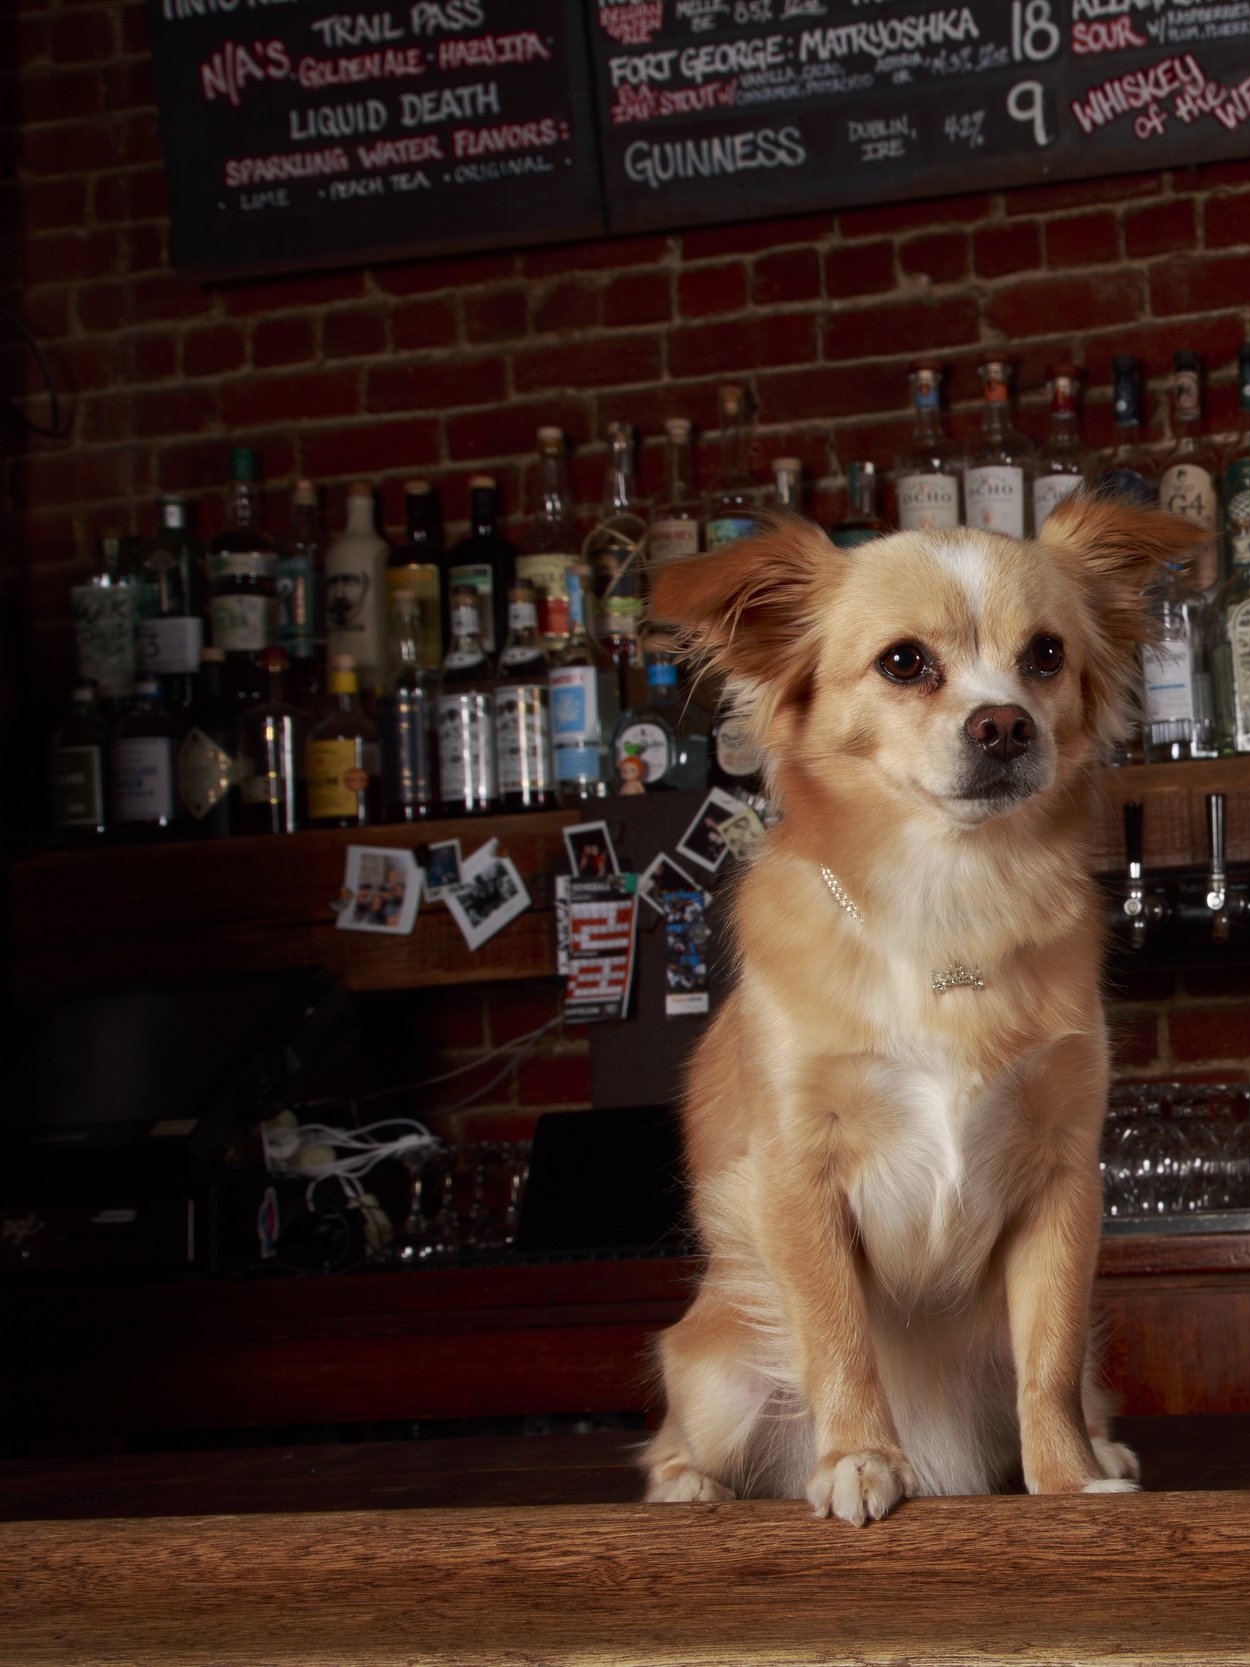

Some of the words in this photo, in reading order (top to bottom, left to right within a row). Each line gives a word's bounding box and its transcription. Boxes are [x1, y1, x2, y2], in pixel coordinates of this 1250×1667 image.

[311, 12, 406, 48] TRAIL
[410, 0, 486, 37] PASS
[800, 7, 980, 63] MATRYOSHKA
[1012, 0, 1060, 62] 18
[1072, 15, 1149, 55] SOUR
[299, 56, 383, 89] GOLDEN
[383, 48, 427, 79] ALE
[608, 50, 680, 88] FORT
[680, 34, 792, 84] GEORGE:
[289, 98, 390, 141] LIQUID
[400, 82, 501, 128] DEATH
[660, 82, 723, 116] STOUT
[1006, 81, 1054, 146] 9
[1072, 52, 1206, 135] WHISKEY
[847, 114, 918, 144] DUBLIN,
[1133, 102, 1169, 141] of
[224, 147, 351, 188] SPARKLING
[358, 135, 446, 171] WATER
[451, 117, 572, 159] FLAVORS:
[453, 154, 556, 185] ORIGINAL
[624, 125, 807, 190] GUINNESS
[239, 187, 292, 212] LIME
[329, 174, 386, 202] PEACH
[388, 170, 432, 192] TEA
